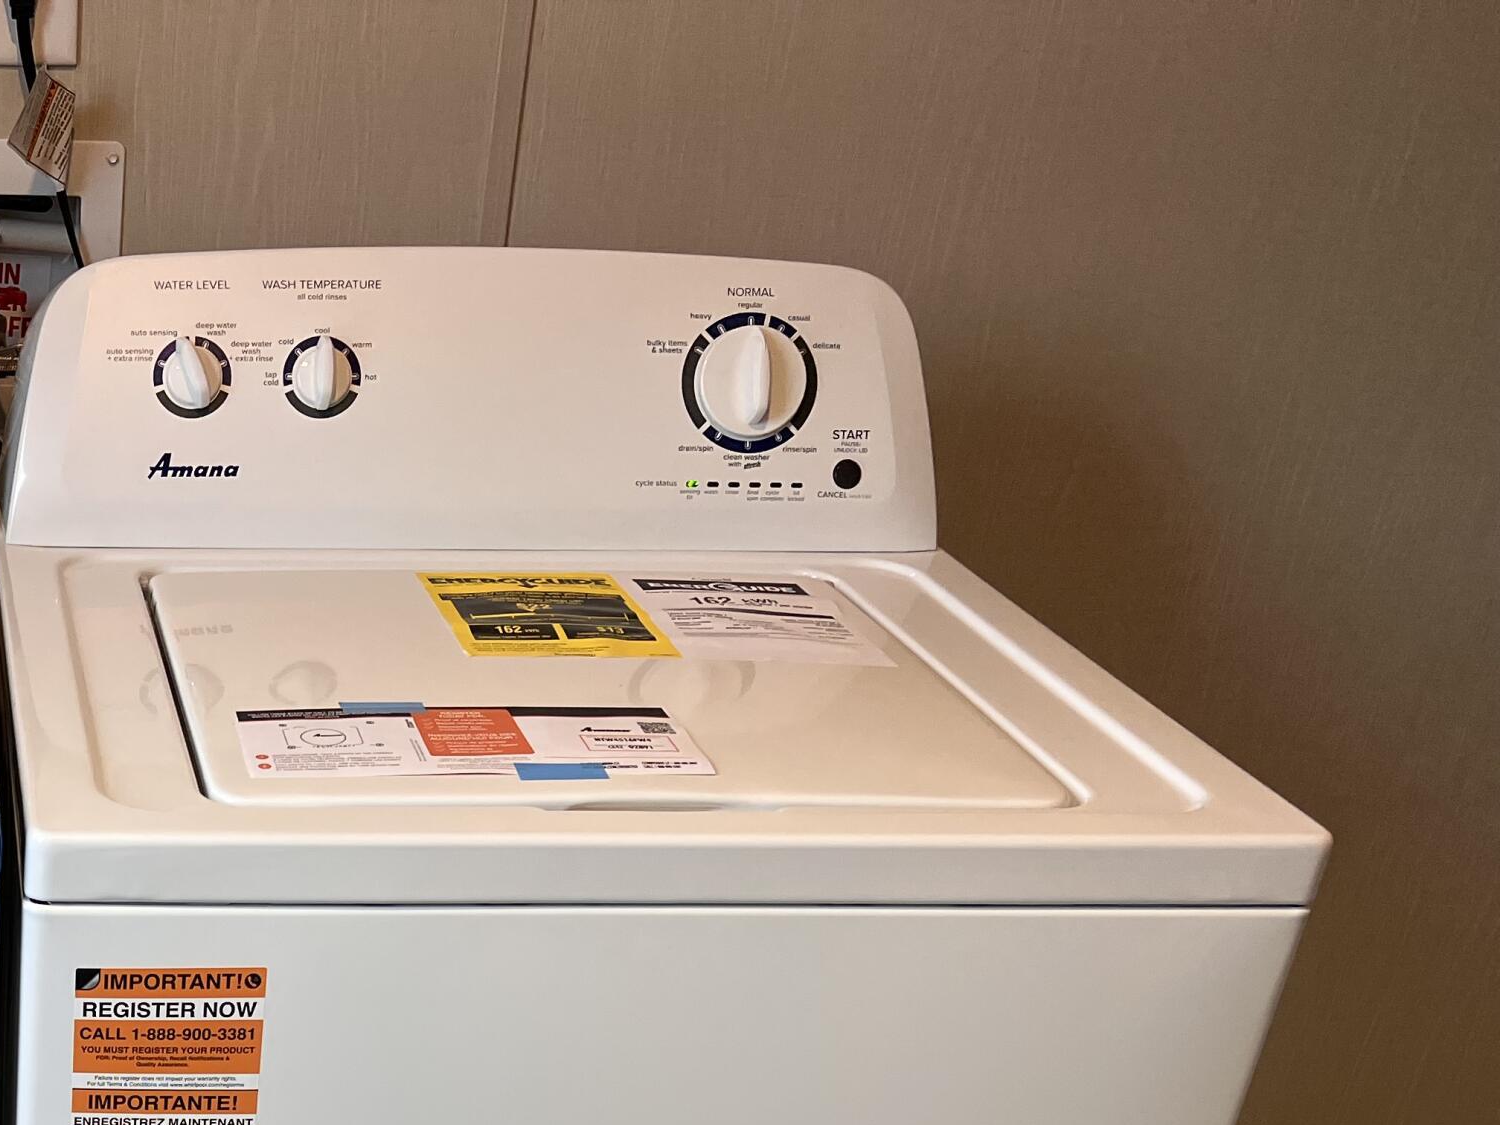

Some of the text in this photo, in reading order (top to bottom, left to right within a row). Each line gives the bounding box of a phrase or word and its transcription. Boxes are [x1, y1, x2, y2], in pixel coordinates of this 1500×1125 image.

[154, 280, 230, 290] WATER LEVEL
[262, 280, 382, 290] WASH TEMPERATURE
[727, 288, 774, 297] NORMAL
[196, 322, 214, 330] deep
[265, 372, 277, 380] tap
[833, 430, 870, 440] START
[148, 453, 239, 479] Amana
[817, 491, 847, 499] CANCEL
[689, 596, 732, 606] 162
[495, 625, 523, 634] 162
[103, 974, 242, 990] IMPORTANT!
[83, 1002, 257, 1018] REGISTER NOW
[80, 1028, 255, 1040] CALL 1-888-900-3381
[88, 1095, 237, 1110] IMPORTANTE!
